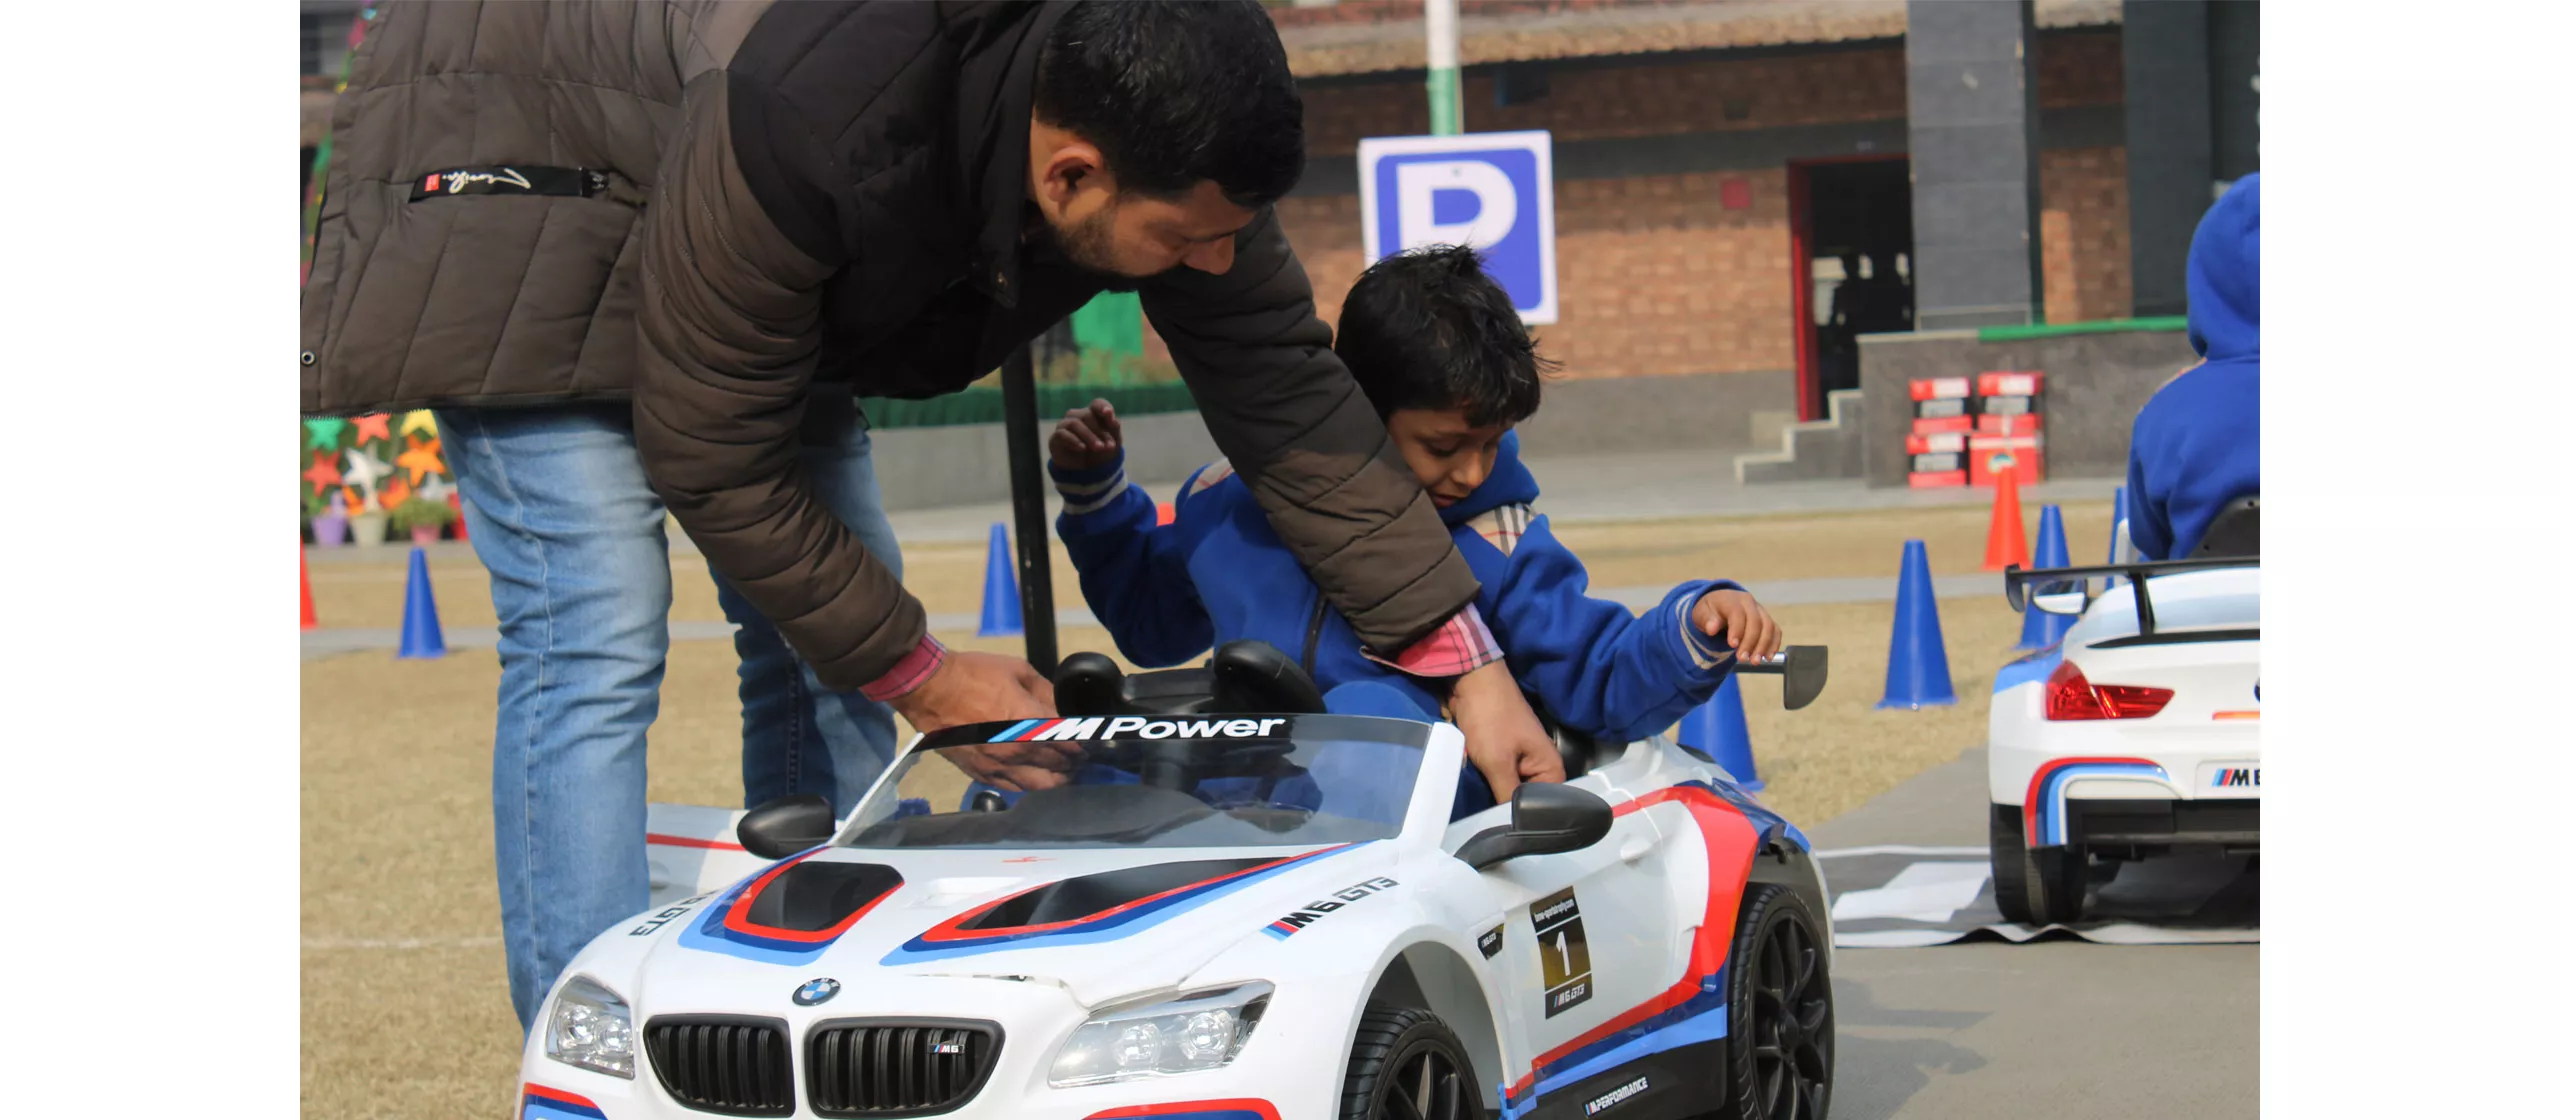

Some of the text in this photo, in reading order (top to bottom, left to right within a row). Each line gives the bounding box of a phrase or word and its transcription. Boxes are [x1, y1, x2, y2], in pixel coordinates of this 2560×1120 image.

[1397, 160, 1518, 252] P
[1331, 876, 1401, 902] GT3
[1555, 930, 1571, 977] 1
